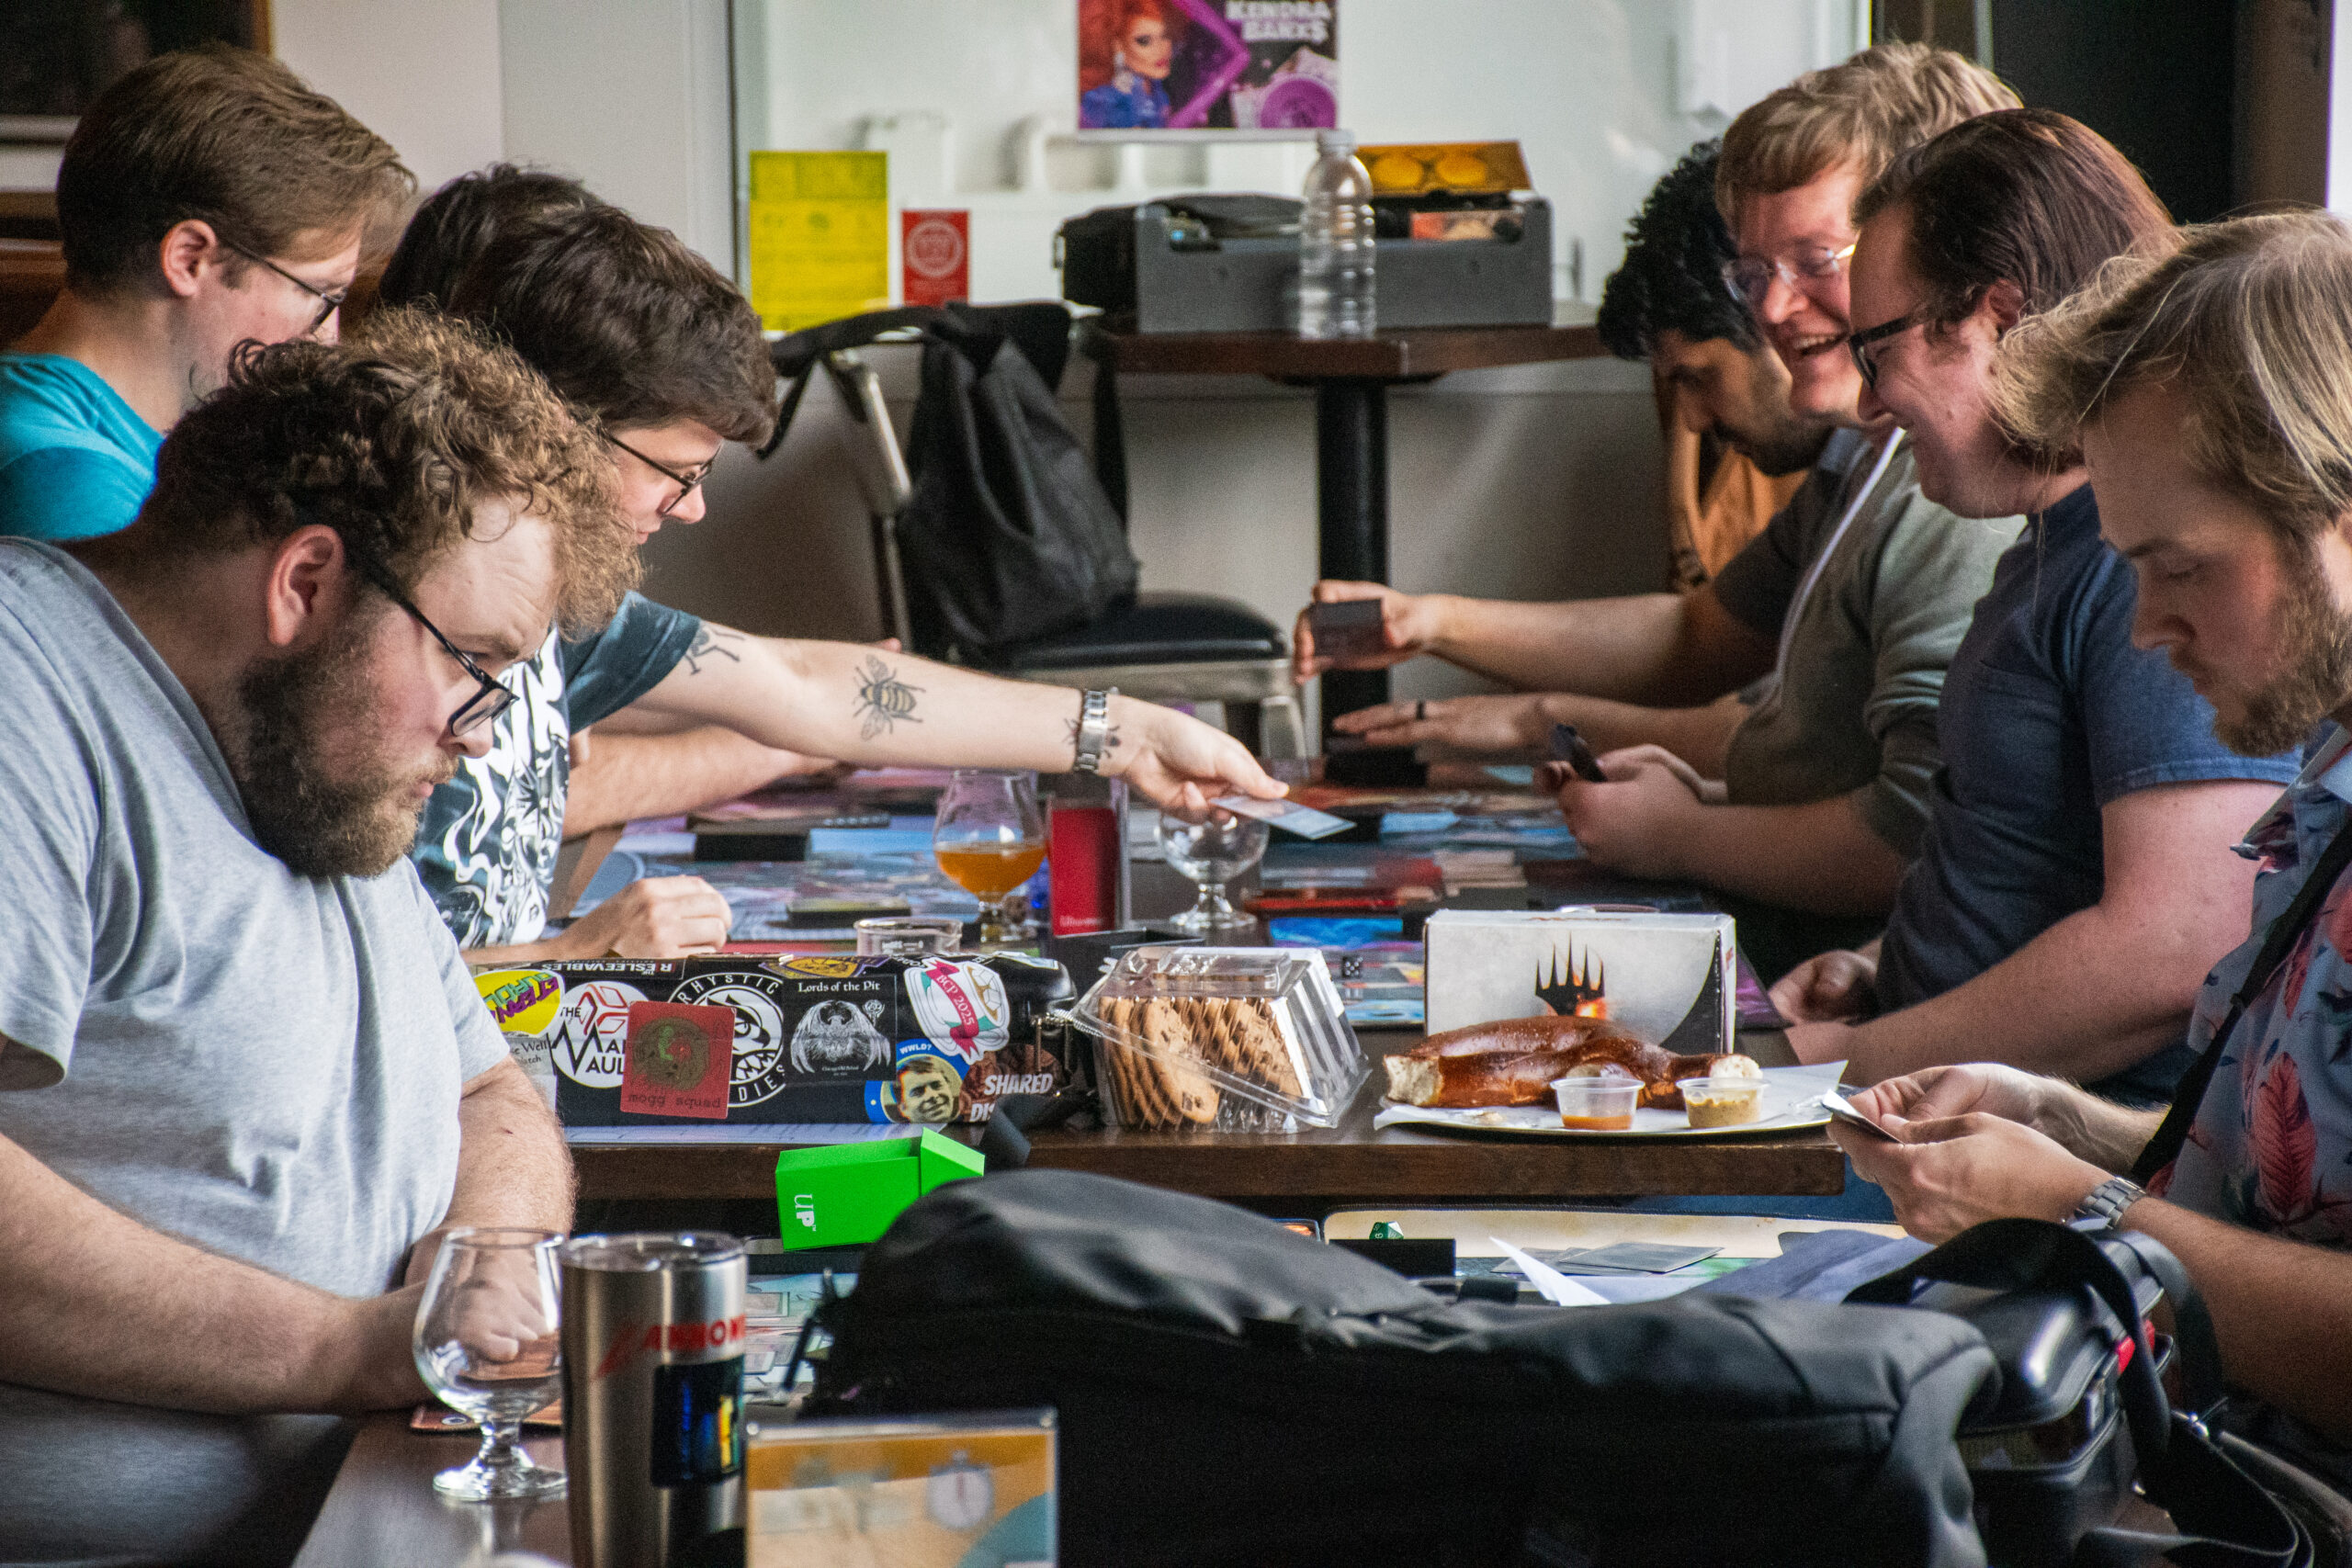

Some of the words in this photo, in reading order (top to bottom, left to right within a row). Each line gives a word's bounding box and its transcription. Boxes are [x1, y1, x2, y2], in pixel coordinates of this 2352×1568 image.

[677, 974, 779, 1005] RHYSTIC
[797, 981, 829, 993] Lords
[831, 981, 842, 992] of
[842, 981, 861, 991] the
[863, 980, 881, 990] Pit
[490, 976, 560, 1023] ETERN
[935, 975, 959, 996] BCP
[953, 995, 976, 1026] 2025
[521, 1039, 548, 1053] Well
[899, 1043, 933, 1055] WWLD?
[983, 1073, 1055, 1096] SHARED
